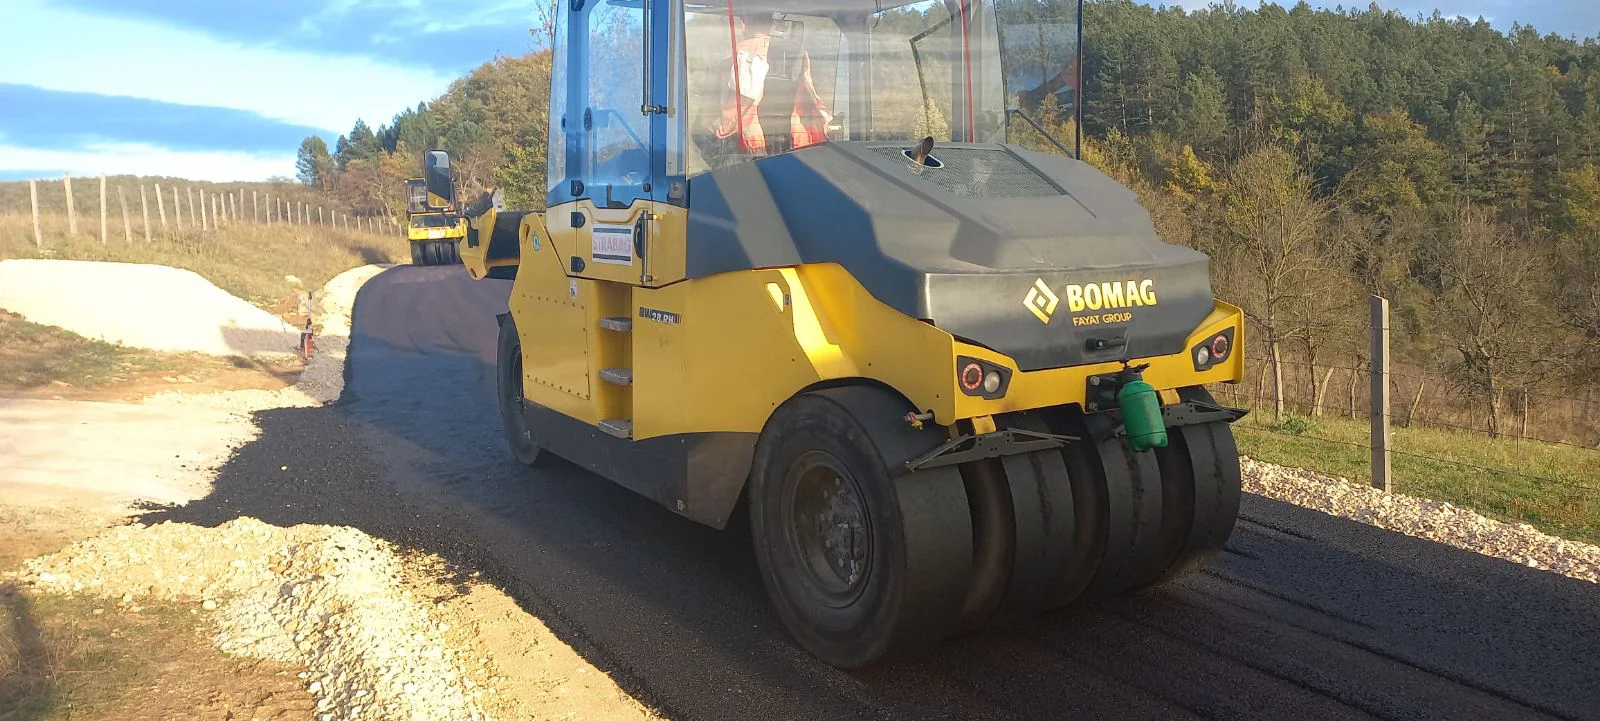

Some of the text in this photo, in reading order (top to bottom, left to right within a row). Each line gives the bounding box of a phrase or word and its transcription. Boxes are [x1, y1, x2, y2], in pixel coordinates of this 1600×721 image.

[1066, 279, 1157, 312] BOMAG
[1072, 312, 1132, 326] FAYAT GROUP
